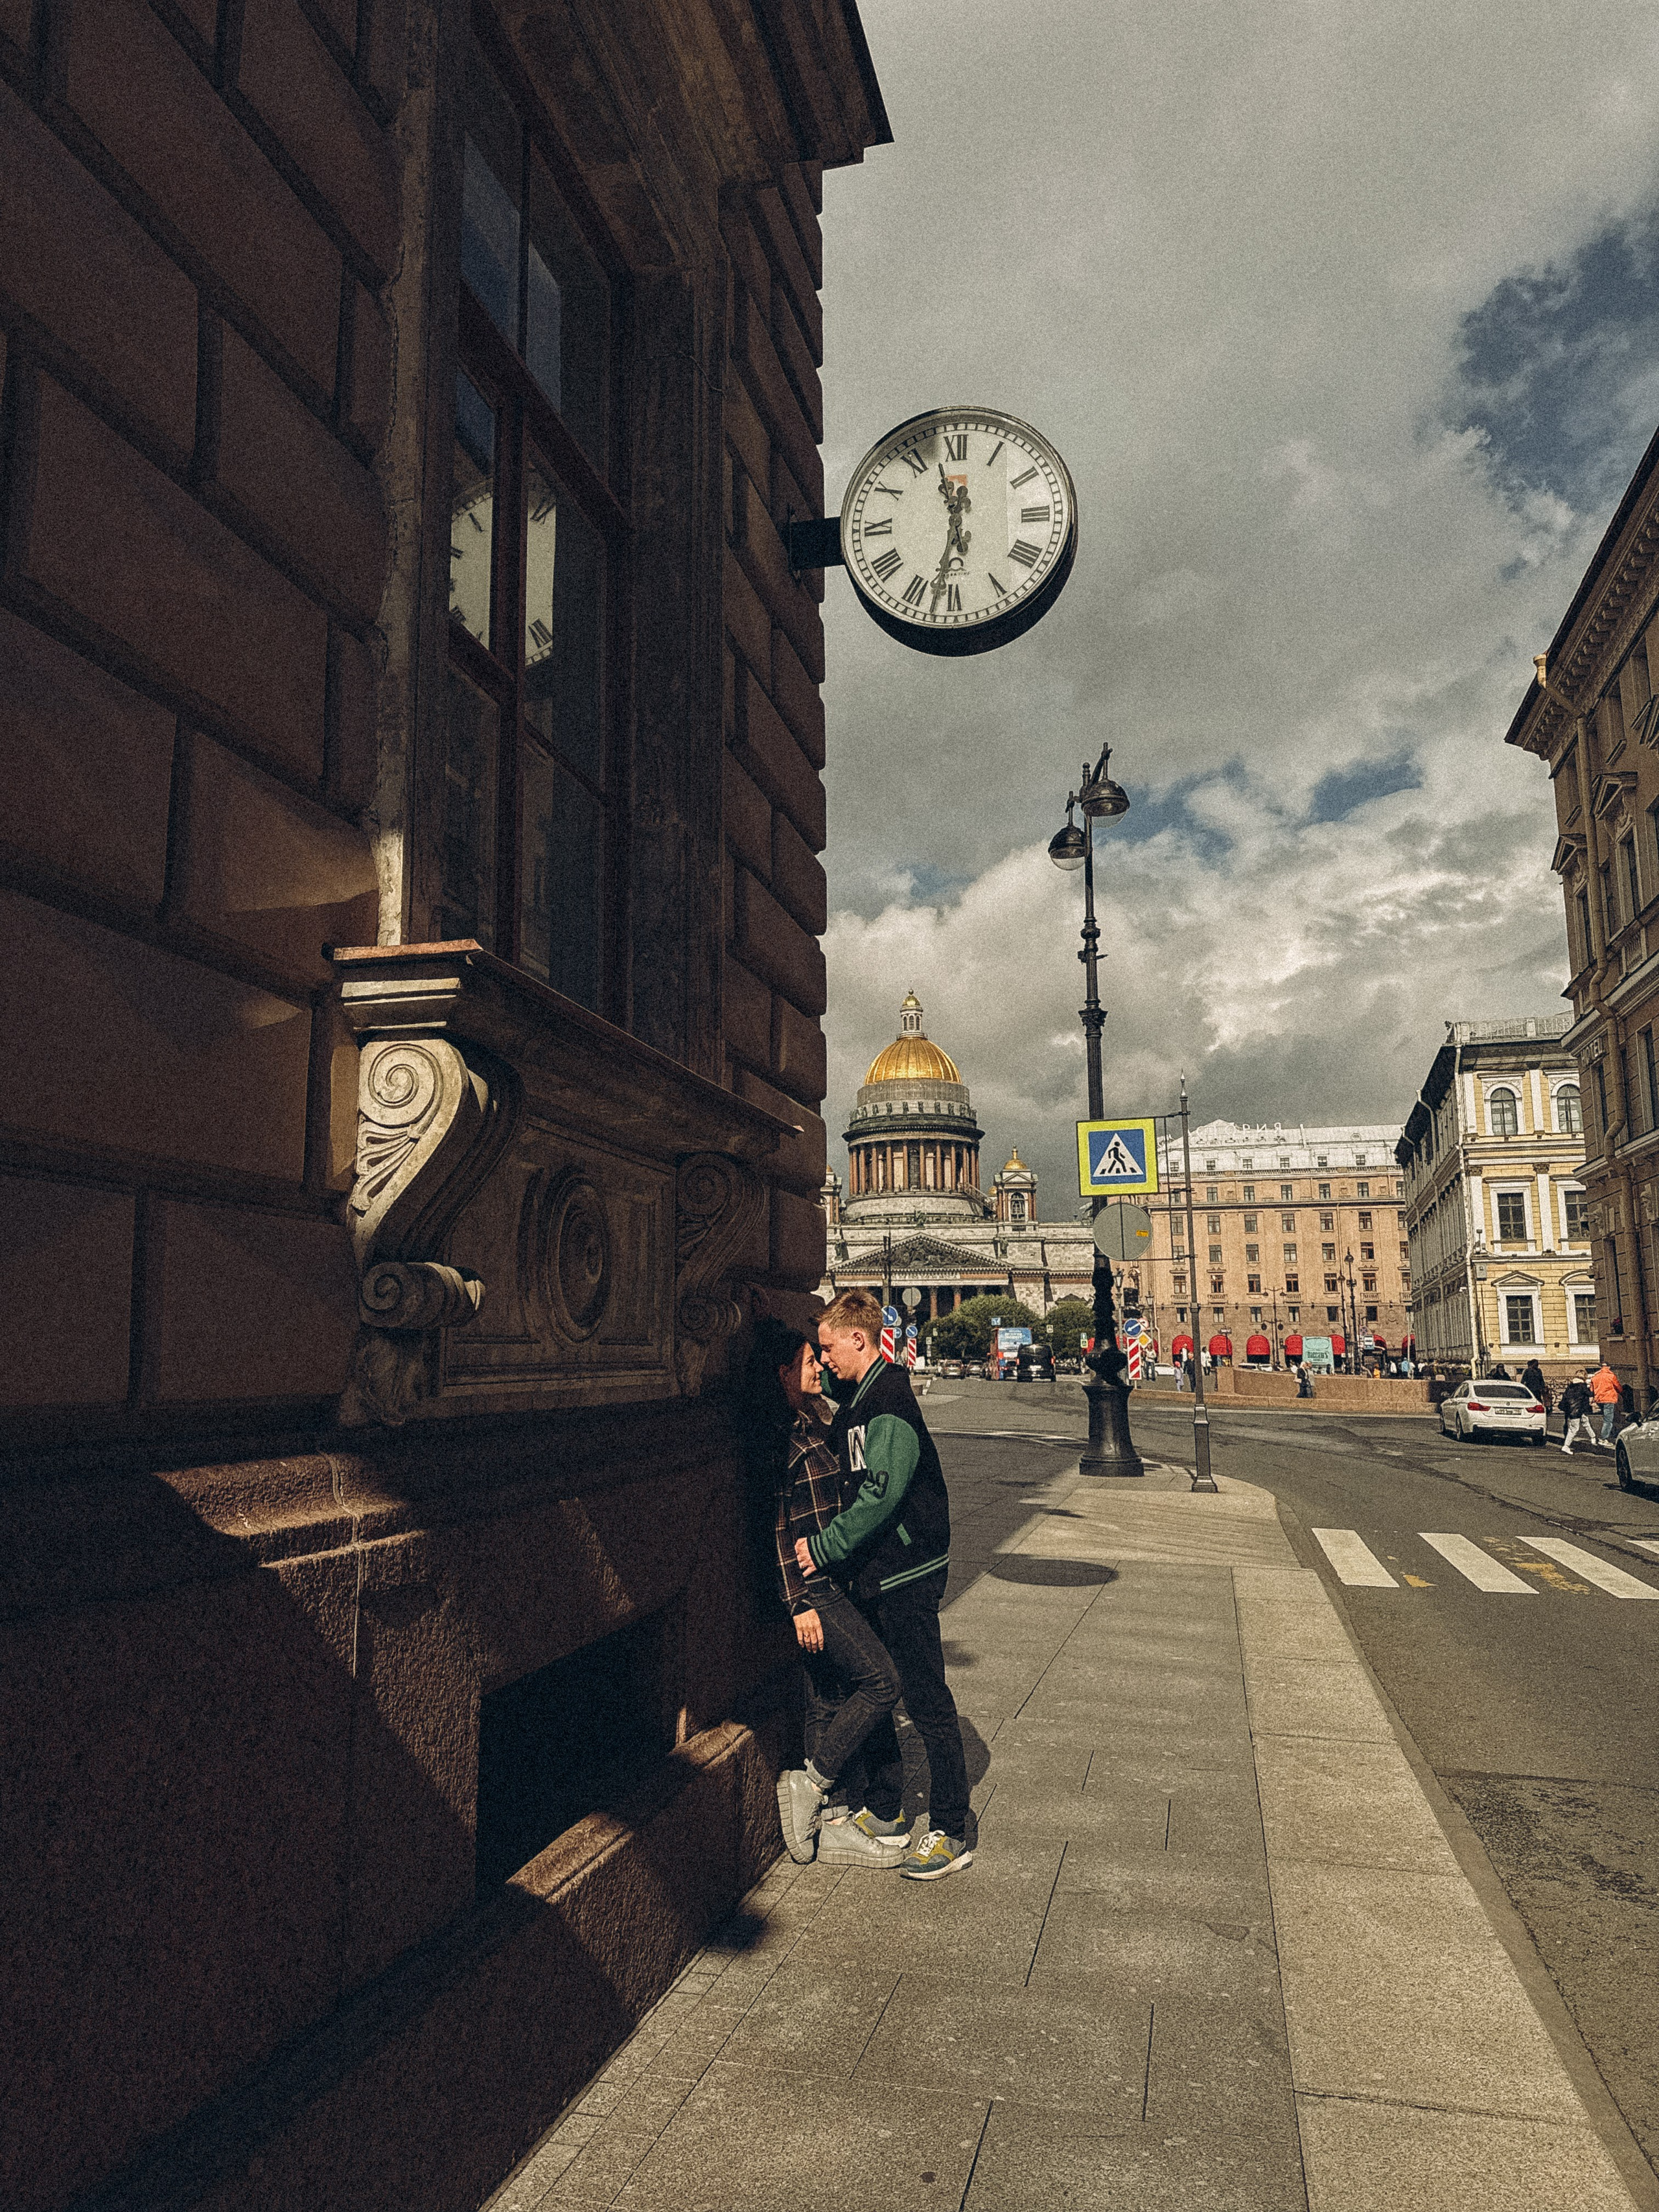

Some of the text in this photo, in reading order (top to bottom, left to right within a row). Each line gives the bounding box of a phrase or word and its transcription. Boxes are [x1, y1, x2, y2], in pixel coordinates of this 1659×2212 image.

[944, 435, 969, 461] XII
[986, 441, 1004, 467] I
[900, 448, 929, 478] XI
[1010, 466, 1039, 489] II
[874, 481, 904, 501] X
[864, 517, 893, 537] IX
[1021, 506, 1050, 523] III
[871, 548, 904, 583] VIII
[1007, 539, 1042, 568] IIII
[901, 574, 929, 607] VII
[946, 583, 962, 612] VI
[988, 572, 1008, 598] V
[1580, 1037, 1603, 1066] HOTEL
